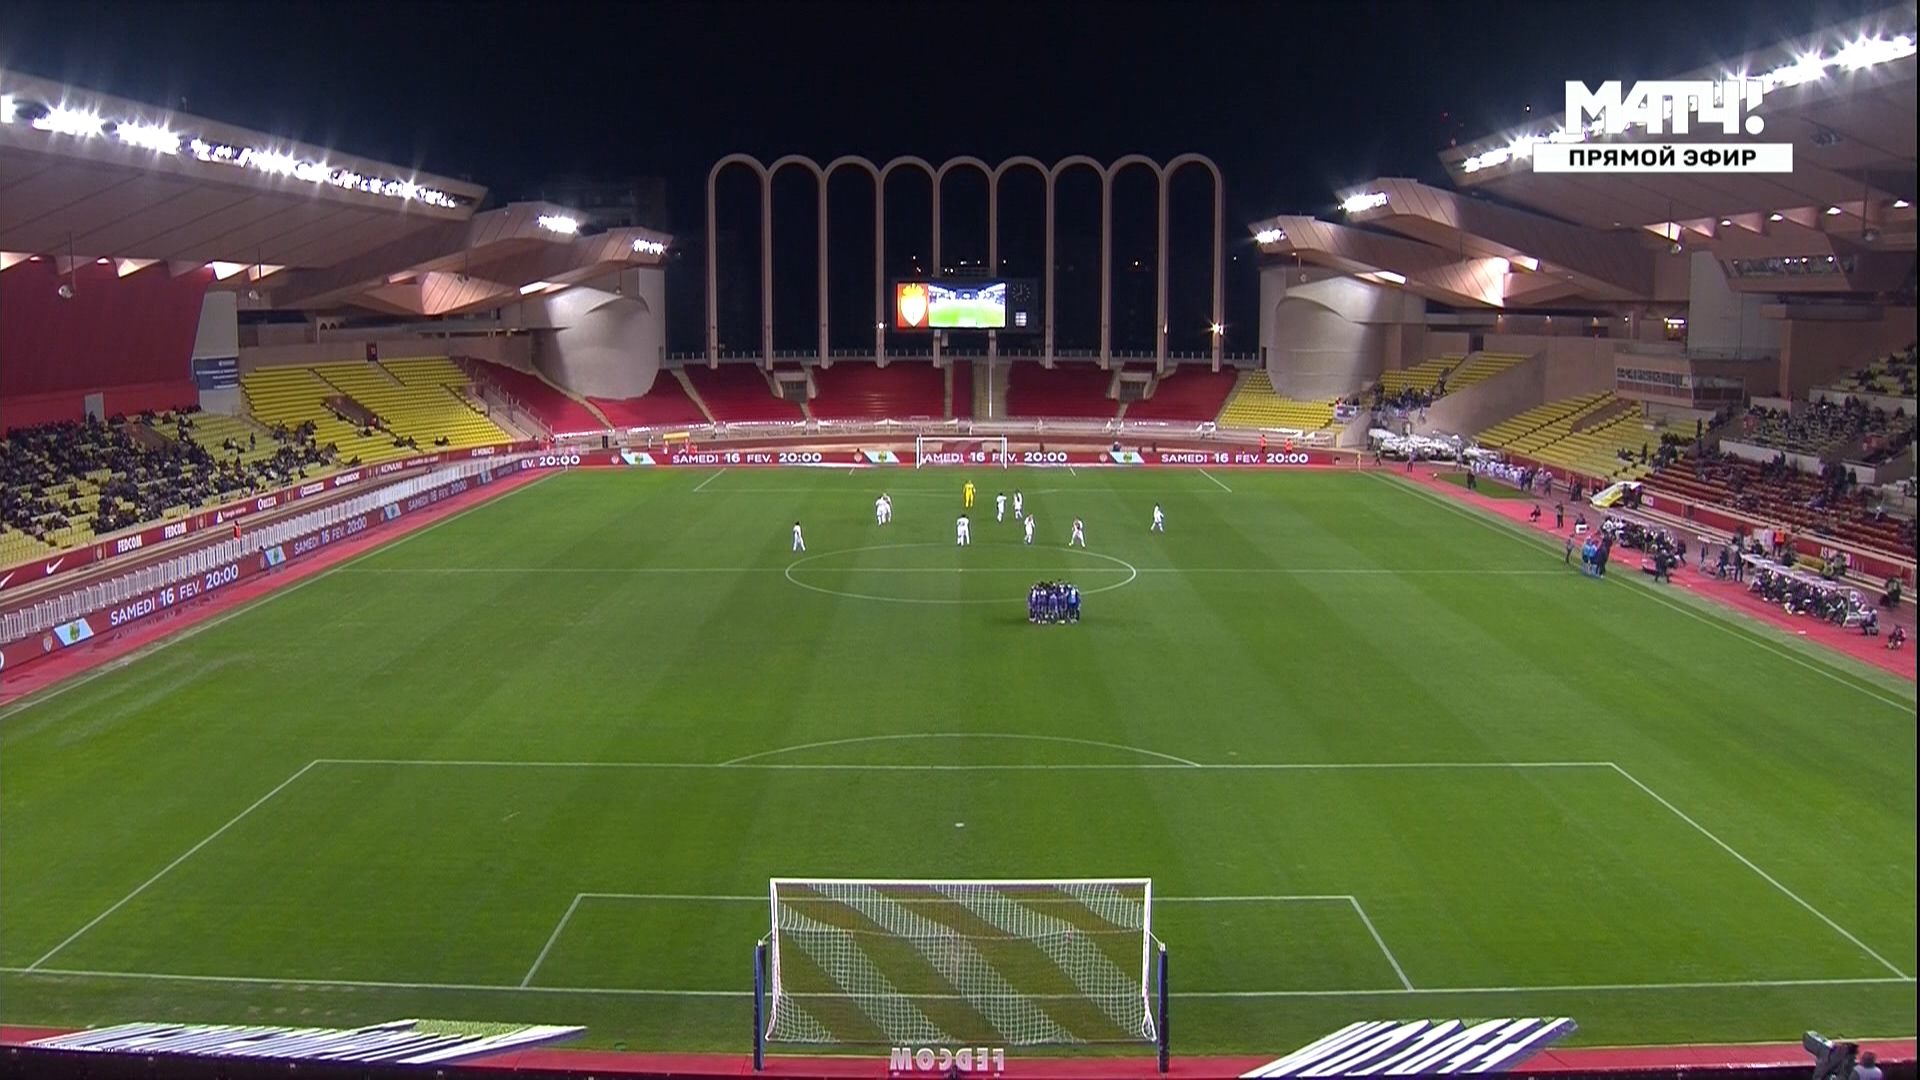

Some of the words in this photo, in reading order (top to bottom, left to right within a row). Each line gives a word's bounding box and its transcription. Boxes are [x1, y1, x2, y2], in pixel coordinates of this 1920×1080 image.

[539, 454, 581, 466] 20:00
[672, 453, 719, 464] SAMEDI
[725, 452, 741, 463] 16
[747, 453, 773, 463] FEV.
[779, 452, 822, 463] 20:00
[970, 452, 986, 462] 16
[1024, 452, 1068, 462] 20:00
[1161, 453, 1208, 464] SAMEDI
[1214, 452, 1229, 463] 16
[1235, 454, 1260, 463] FEV.
[1267, 453, 1309, 464] 20:00
[164, 521, 187, 539] FEDCOM
[294, 537, 319, 555] SAMEDI
[321, 530, 330, 545] 16
[347, 516, 368, 535] 20:00
[117, 534, 143, 553] FEDCOM
[111, 597, 156, 626] SAMEDI
[160, 587, 175, 606] 16
[180, 580, 201, 600] FEV.
[205, 564, 239, 589] 20:00
